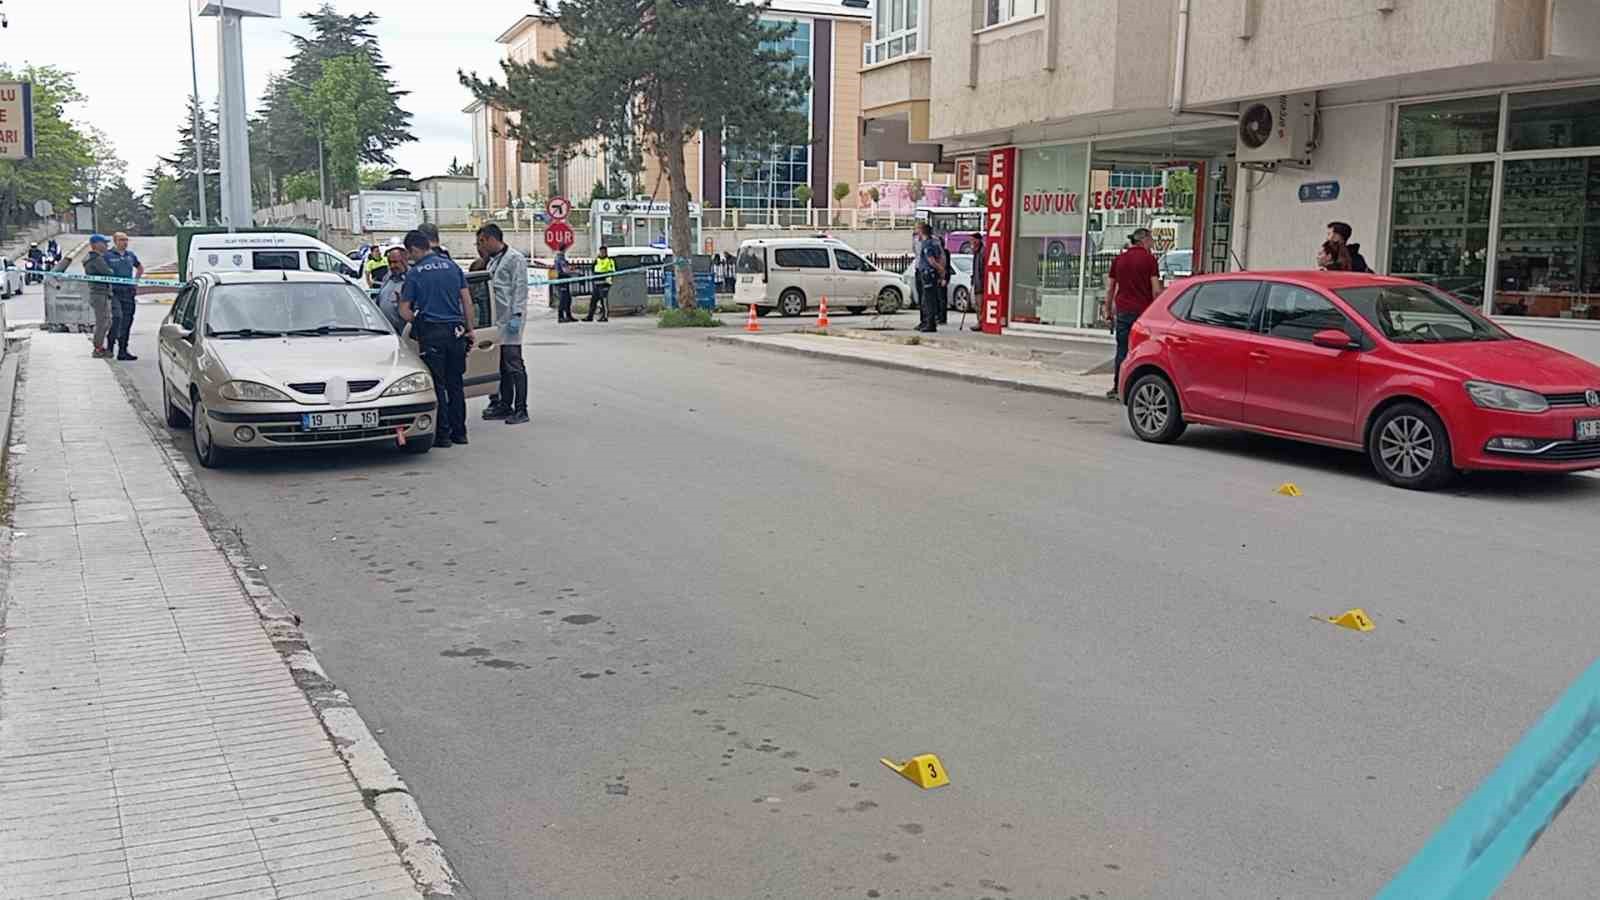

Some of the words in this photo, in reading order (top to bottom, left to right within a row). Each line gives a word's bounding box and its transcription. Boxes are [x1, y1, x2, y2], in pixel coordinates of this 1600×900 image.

[1094, 186, 1165, 210] ECZANE
[547, 231, 572, 244] DUR
[986, 153, 1004, 325] ECZANE
[312, 414, 323, 426] 19
[336, 414, 348, 425] TY
[361, 412, 378, 425] 161
[1356, 615, 1365, 626] 2
[927, 763, 937, 778] 3
